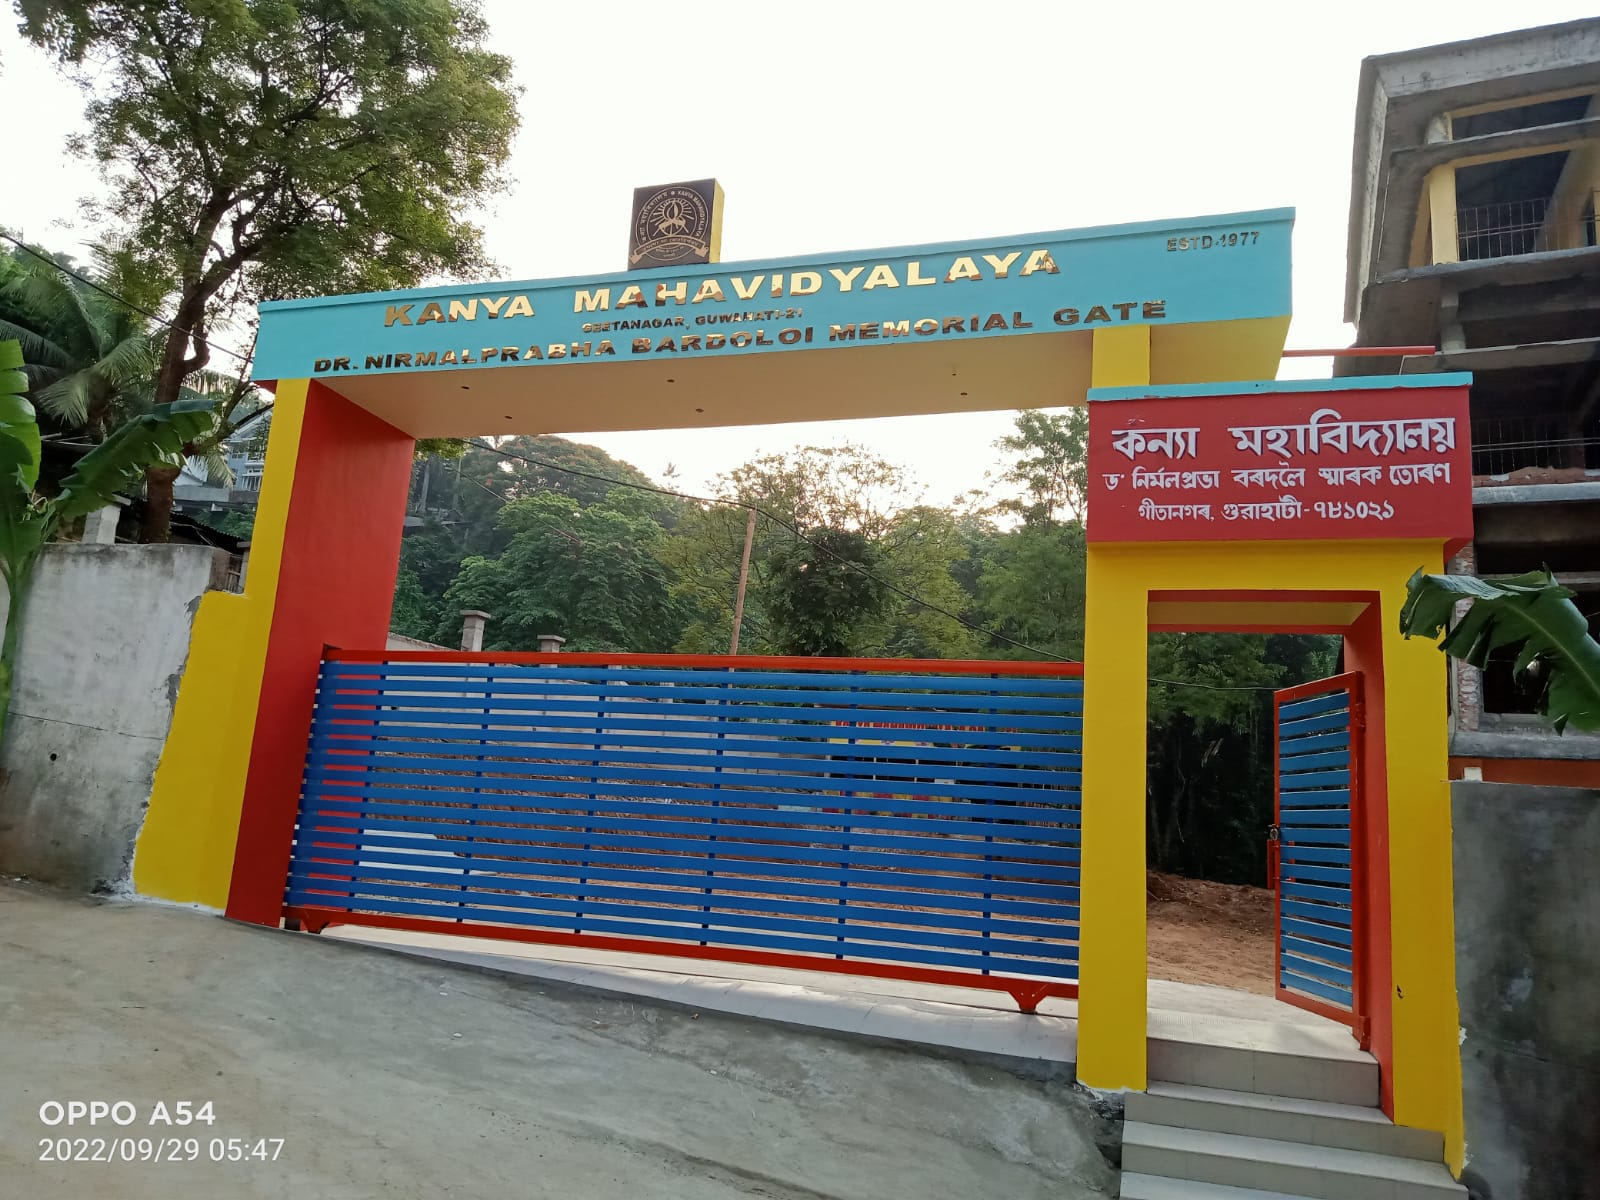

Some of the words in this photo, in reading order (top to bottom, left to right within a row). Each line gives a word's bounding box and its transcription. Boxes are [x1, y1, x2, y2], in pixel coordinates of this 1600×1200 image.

[384, 295, 536, 328] KANYA
[573, 249, 1061, 313] MAHAVIDYALAYA
[314, 356, 359, 373] DR.
[364, 339, 616, 370] NIRMALPRABHA
[631, 326, 814, 354] BARDOLOI
[829, 311, 1033, 342] MEMORIAL
[1053, 299, 1166, 326] GATE
[581, 315, 691, 334] GEETANAGAR,
[694, 307, 803, 326] GUWAHATI-21
[1111, 427, 1201, 461] কন্যা
[1227, 408, 1456, 459] মহাবিদ্যালয়
[1132, 465, 1221, 490] নির্মলপ্রভা
[1318, 465, 1383, 487] স্মাৰক
[1389, 462, 1451, 486] তোৰণ
